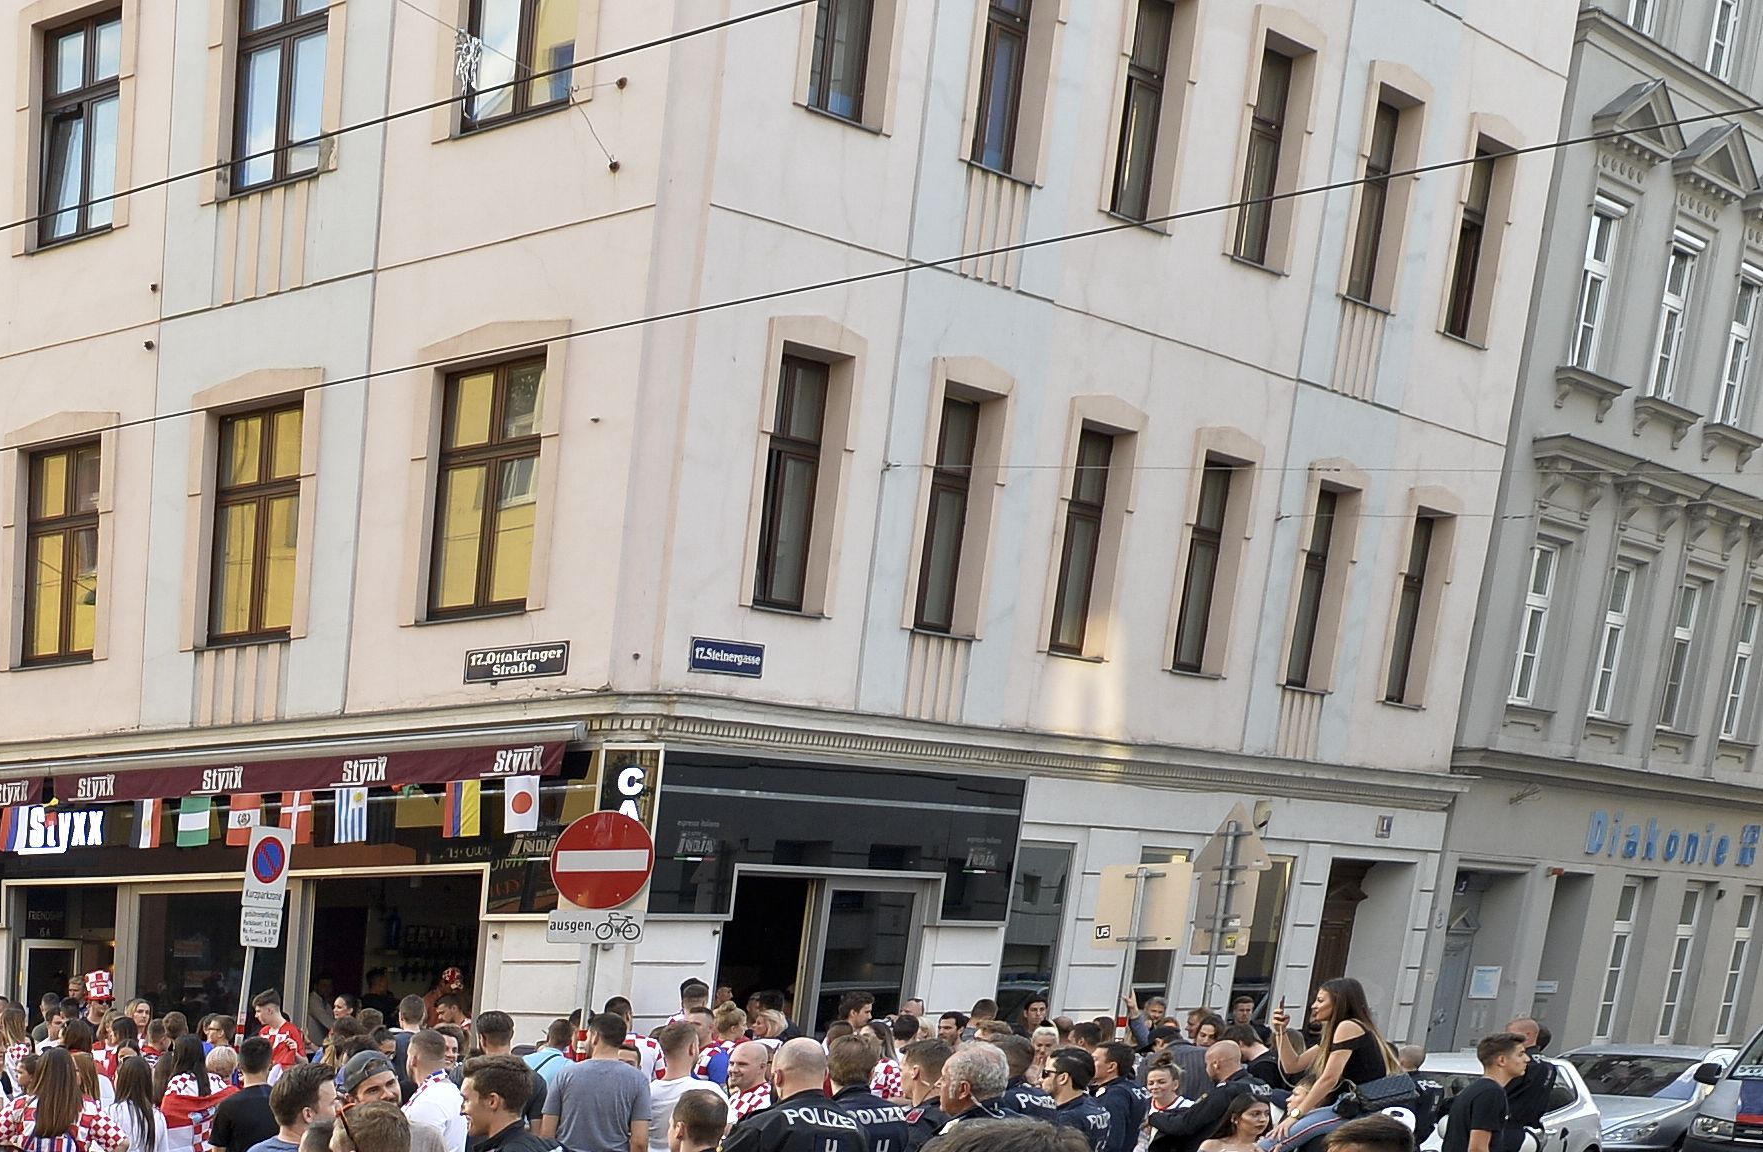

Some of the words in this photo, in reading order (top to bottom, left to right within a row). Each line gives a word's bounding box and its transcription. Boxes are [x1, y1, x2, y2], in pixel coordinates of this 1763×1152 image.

[492, 663, 536, 675] Straße
[1585, 810, 1730, 866] Diakonie
[549, 919, 595, 935] ausgen.
